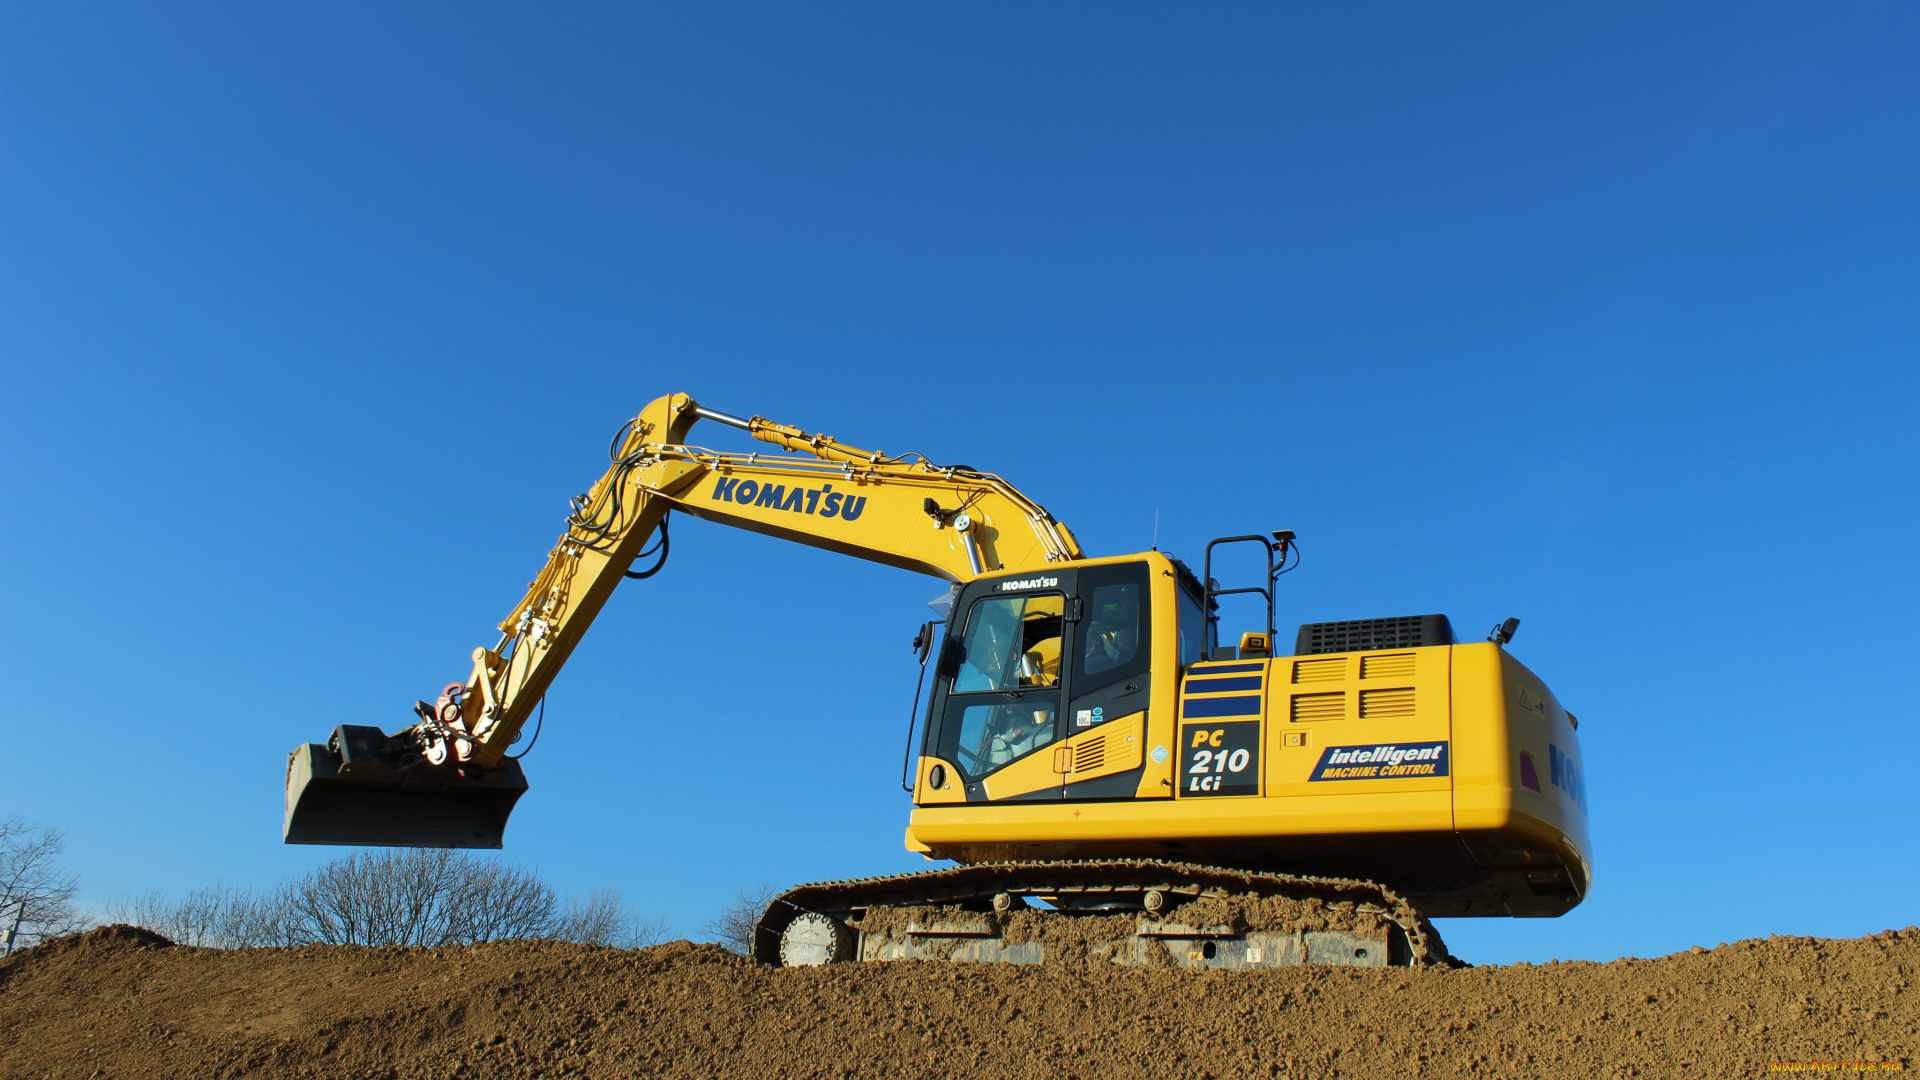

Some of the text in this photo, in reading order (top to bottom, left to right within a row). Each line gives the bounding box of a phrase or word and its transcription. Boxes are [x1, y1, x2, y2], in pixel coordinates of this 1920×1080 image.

[711, 476, 867, 521] KOMATSU
[1002, 576, 1058, 591] KOMATSU
[1191, 729, 1225, 748] PC
[1189, 748, 1250, 773] 210
[1328, 745, 1442, 766] intelligent
[1321, 763, 1436, 779] MACHINE CONTROL
[1189, 776, 1222, 792] LCi
